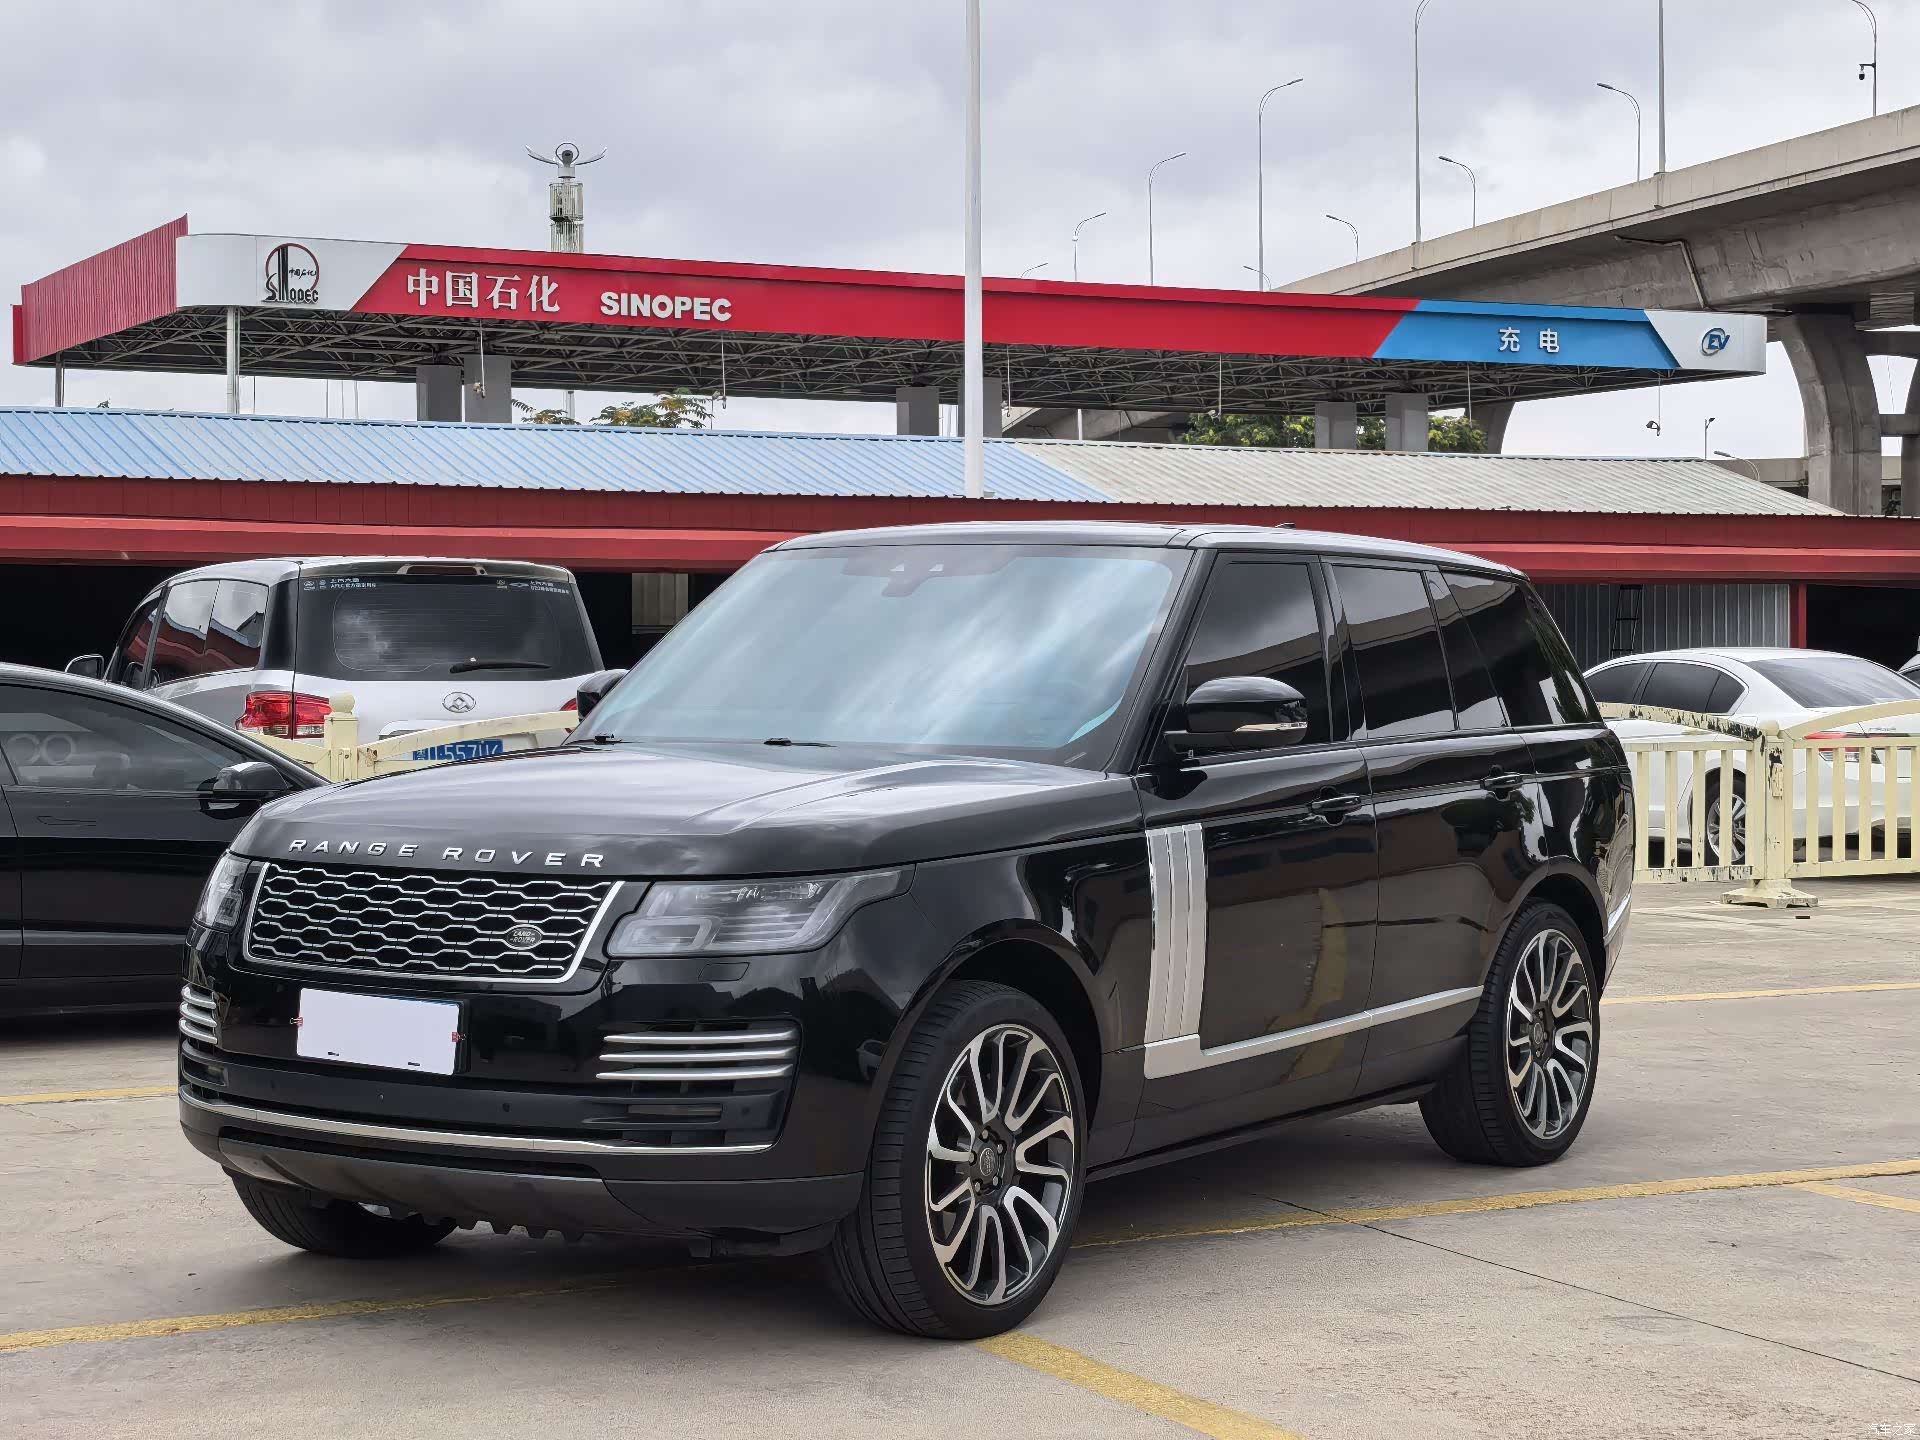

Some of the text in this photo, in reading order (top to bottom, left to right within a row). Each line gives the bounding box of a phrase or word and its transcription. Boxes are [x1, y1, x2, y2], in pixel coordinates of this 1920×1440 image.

[406, 267, 561, 313] 中国石化
[600, 291, 732, 322] SINOPEC
[1499, 326, 1560, 353] 充电
[288, 839, 604, 868] RANGE ROVER
